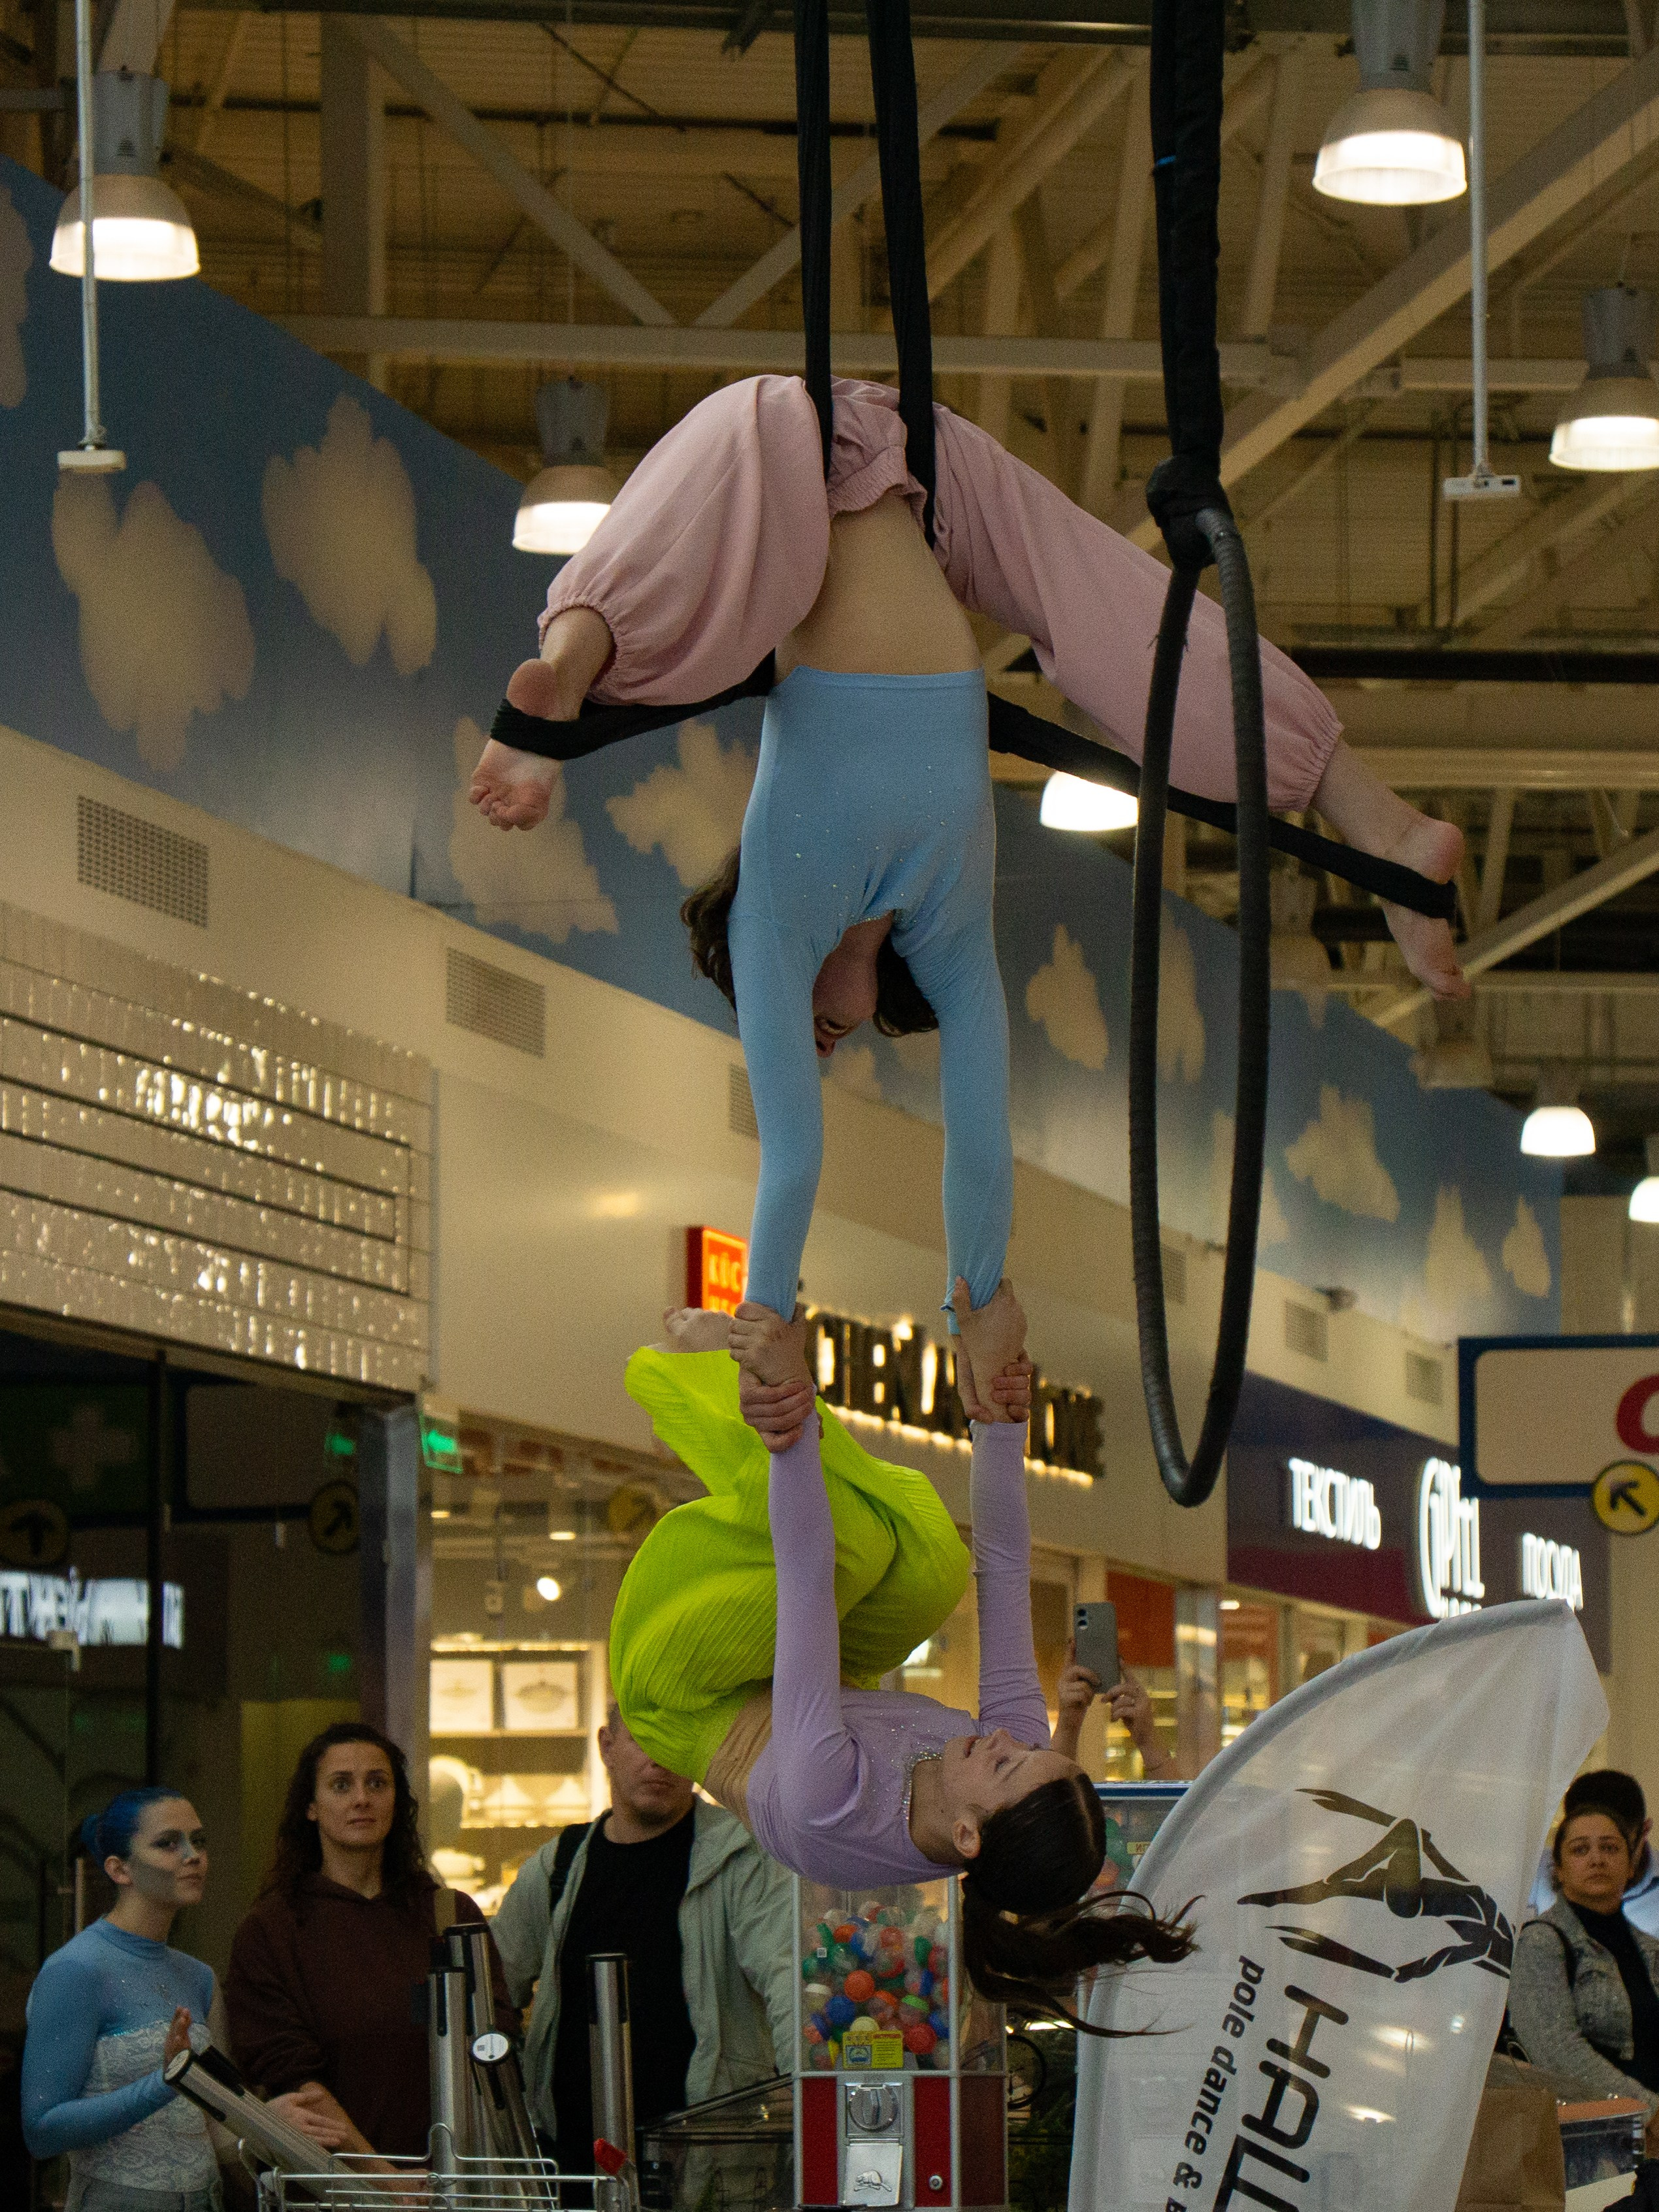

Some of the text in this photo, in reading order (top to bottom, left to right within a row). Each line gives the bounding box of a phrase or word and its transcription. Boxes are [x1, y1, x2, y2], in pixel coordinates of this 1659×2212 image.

[1289, 1457, 1382, 1550] ТЕКСТИЛЬ
[1221, 1955, 1266, 2038] pole
[1184, 2045, 1237, 2156] dance
[1172, 2161, 1203, 2189] &
